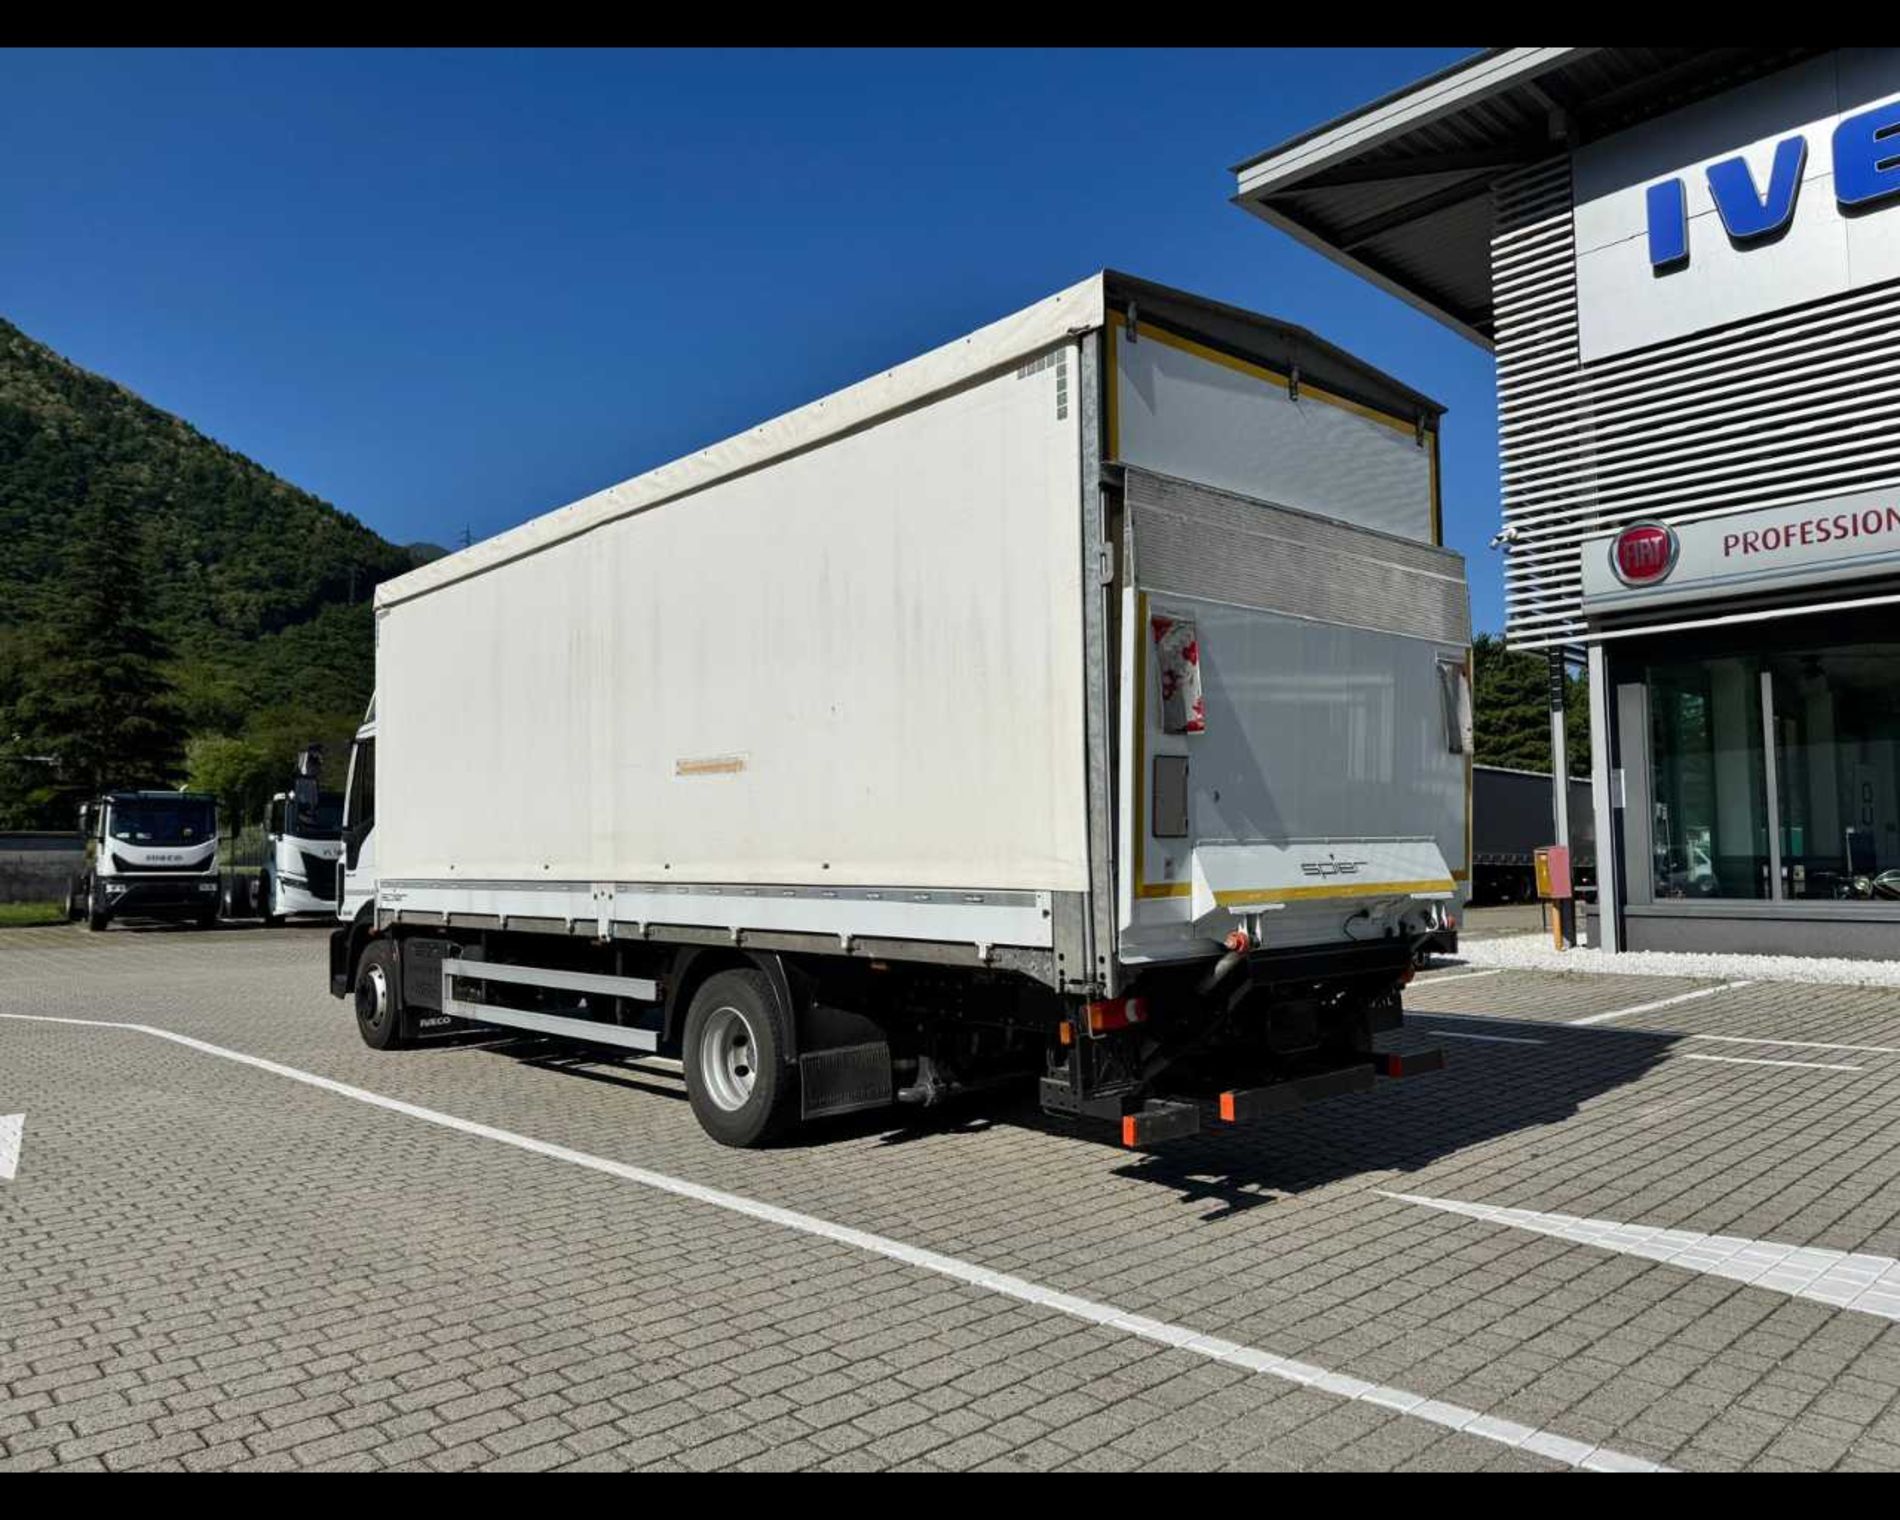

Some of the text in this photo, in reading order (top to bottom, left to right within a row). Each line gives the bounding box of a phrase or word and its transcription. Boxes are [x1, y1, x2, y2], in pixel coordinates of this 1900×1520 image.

[1646, 100, 1900, 268] IVE
[1623, 535, 1664, 569] FIAT
[1723, 507, 1900, 557] PROFESSION
